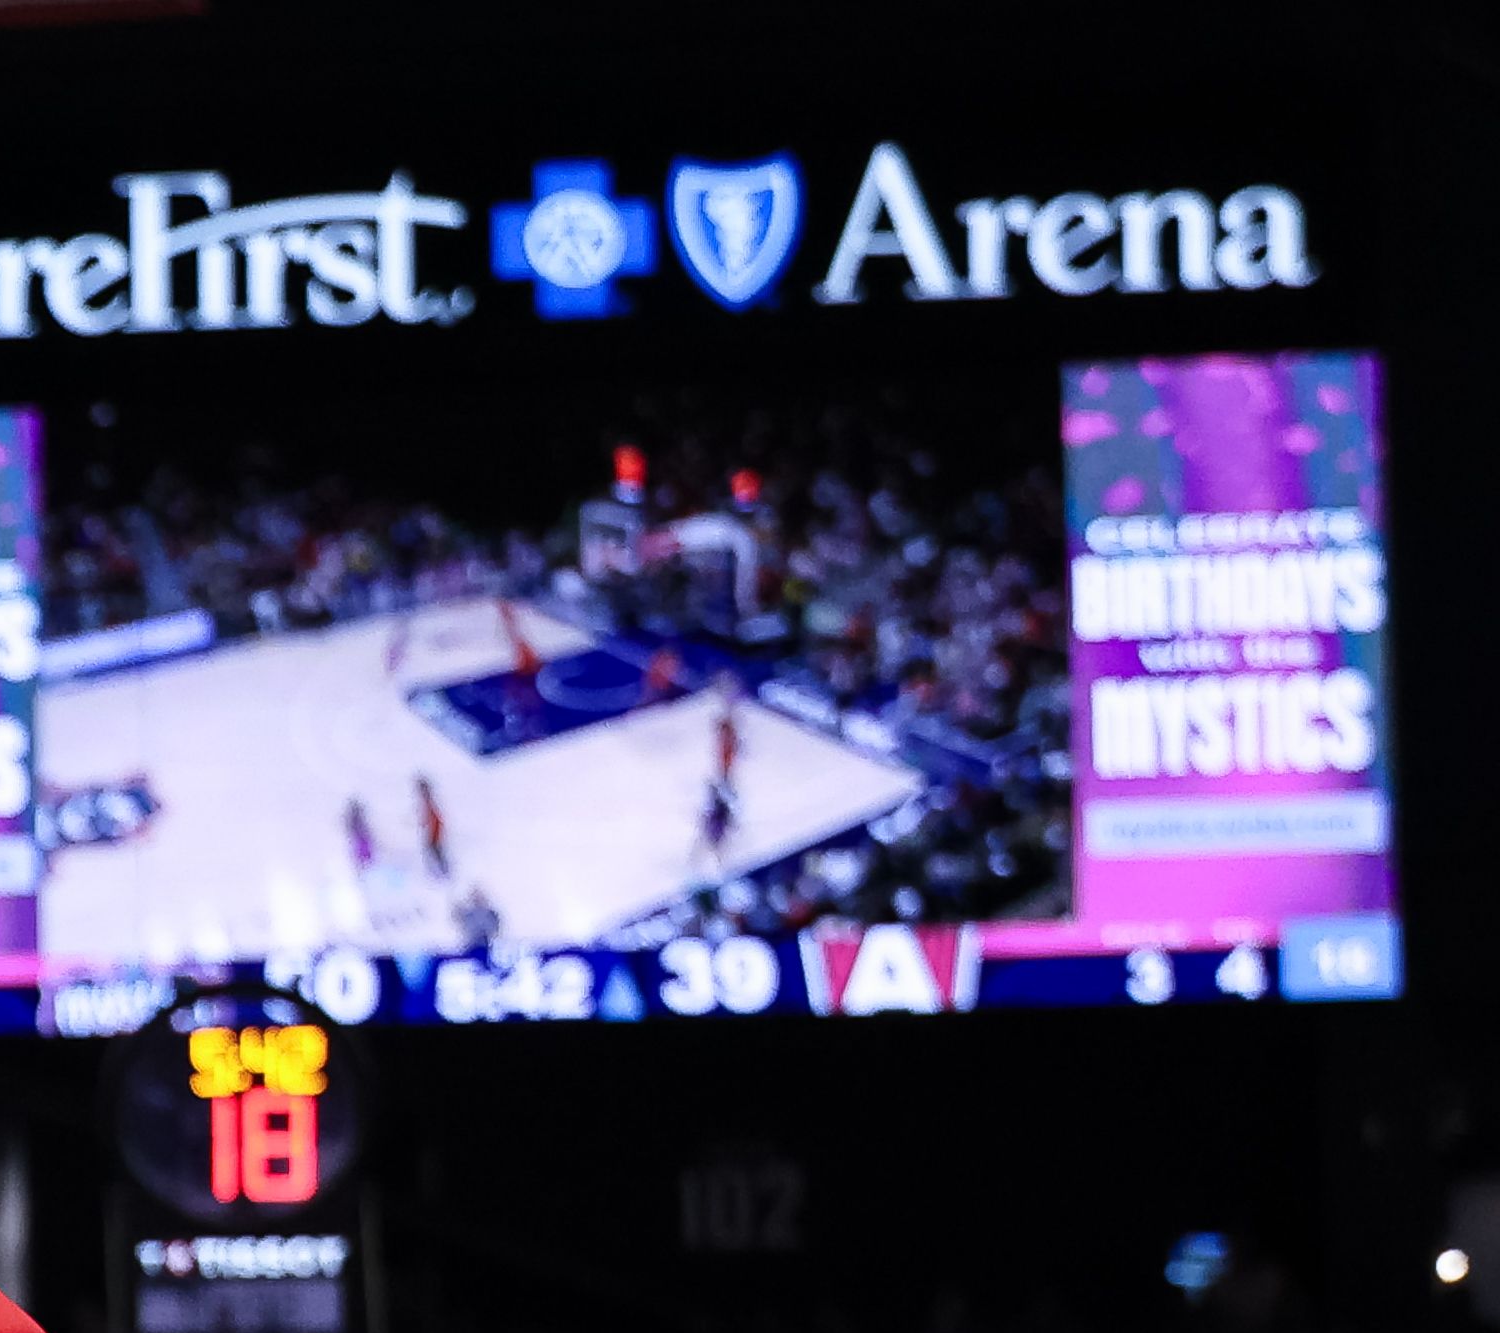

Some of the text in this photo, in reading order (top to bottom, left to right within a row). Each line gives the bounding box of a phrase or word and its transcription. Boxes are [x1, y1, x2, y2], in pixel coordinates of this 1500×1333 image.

[812, 140, 1324, 306] Arena
[1071, 550, 1388, 642] BIRTHDAYS
[1090, 667, 1377, 780] MYSTICS
[660, 934, 782, 1016] 39
[1125, 947, 1177, 1004] 3
[210, 1086, 320, 1204] 18
[680, 1158, 805, 1252] 102
